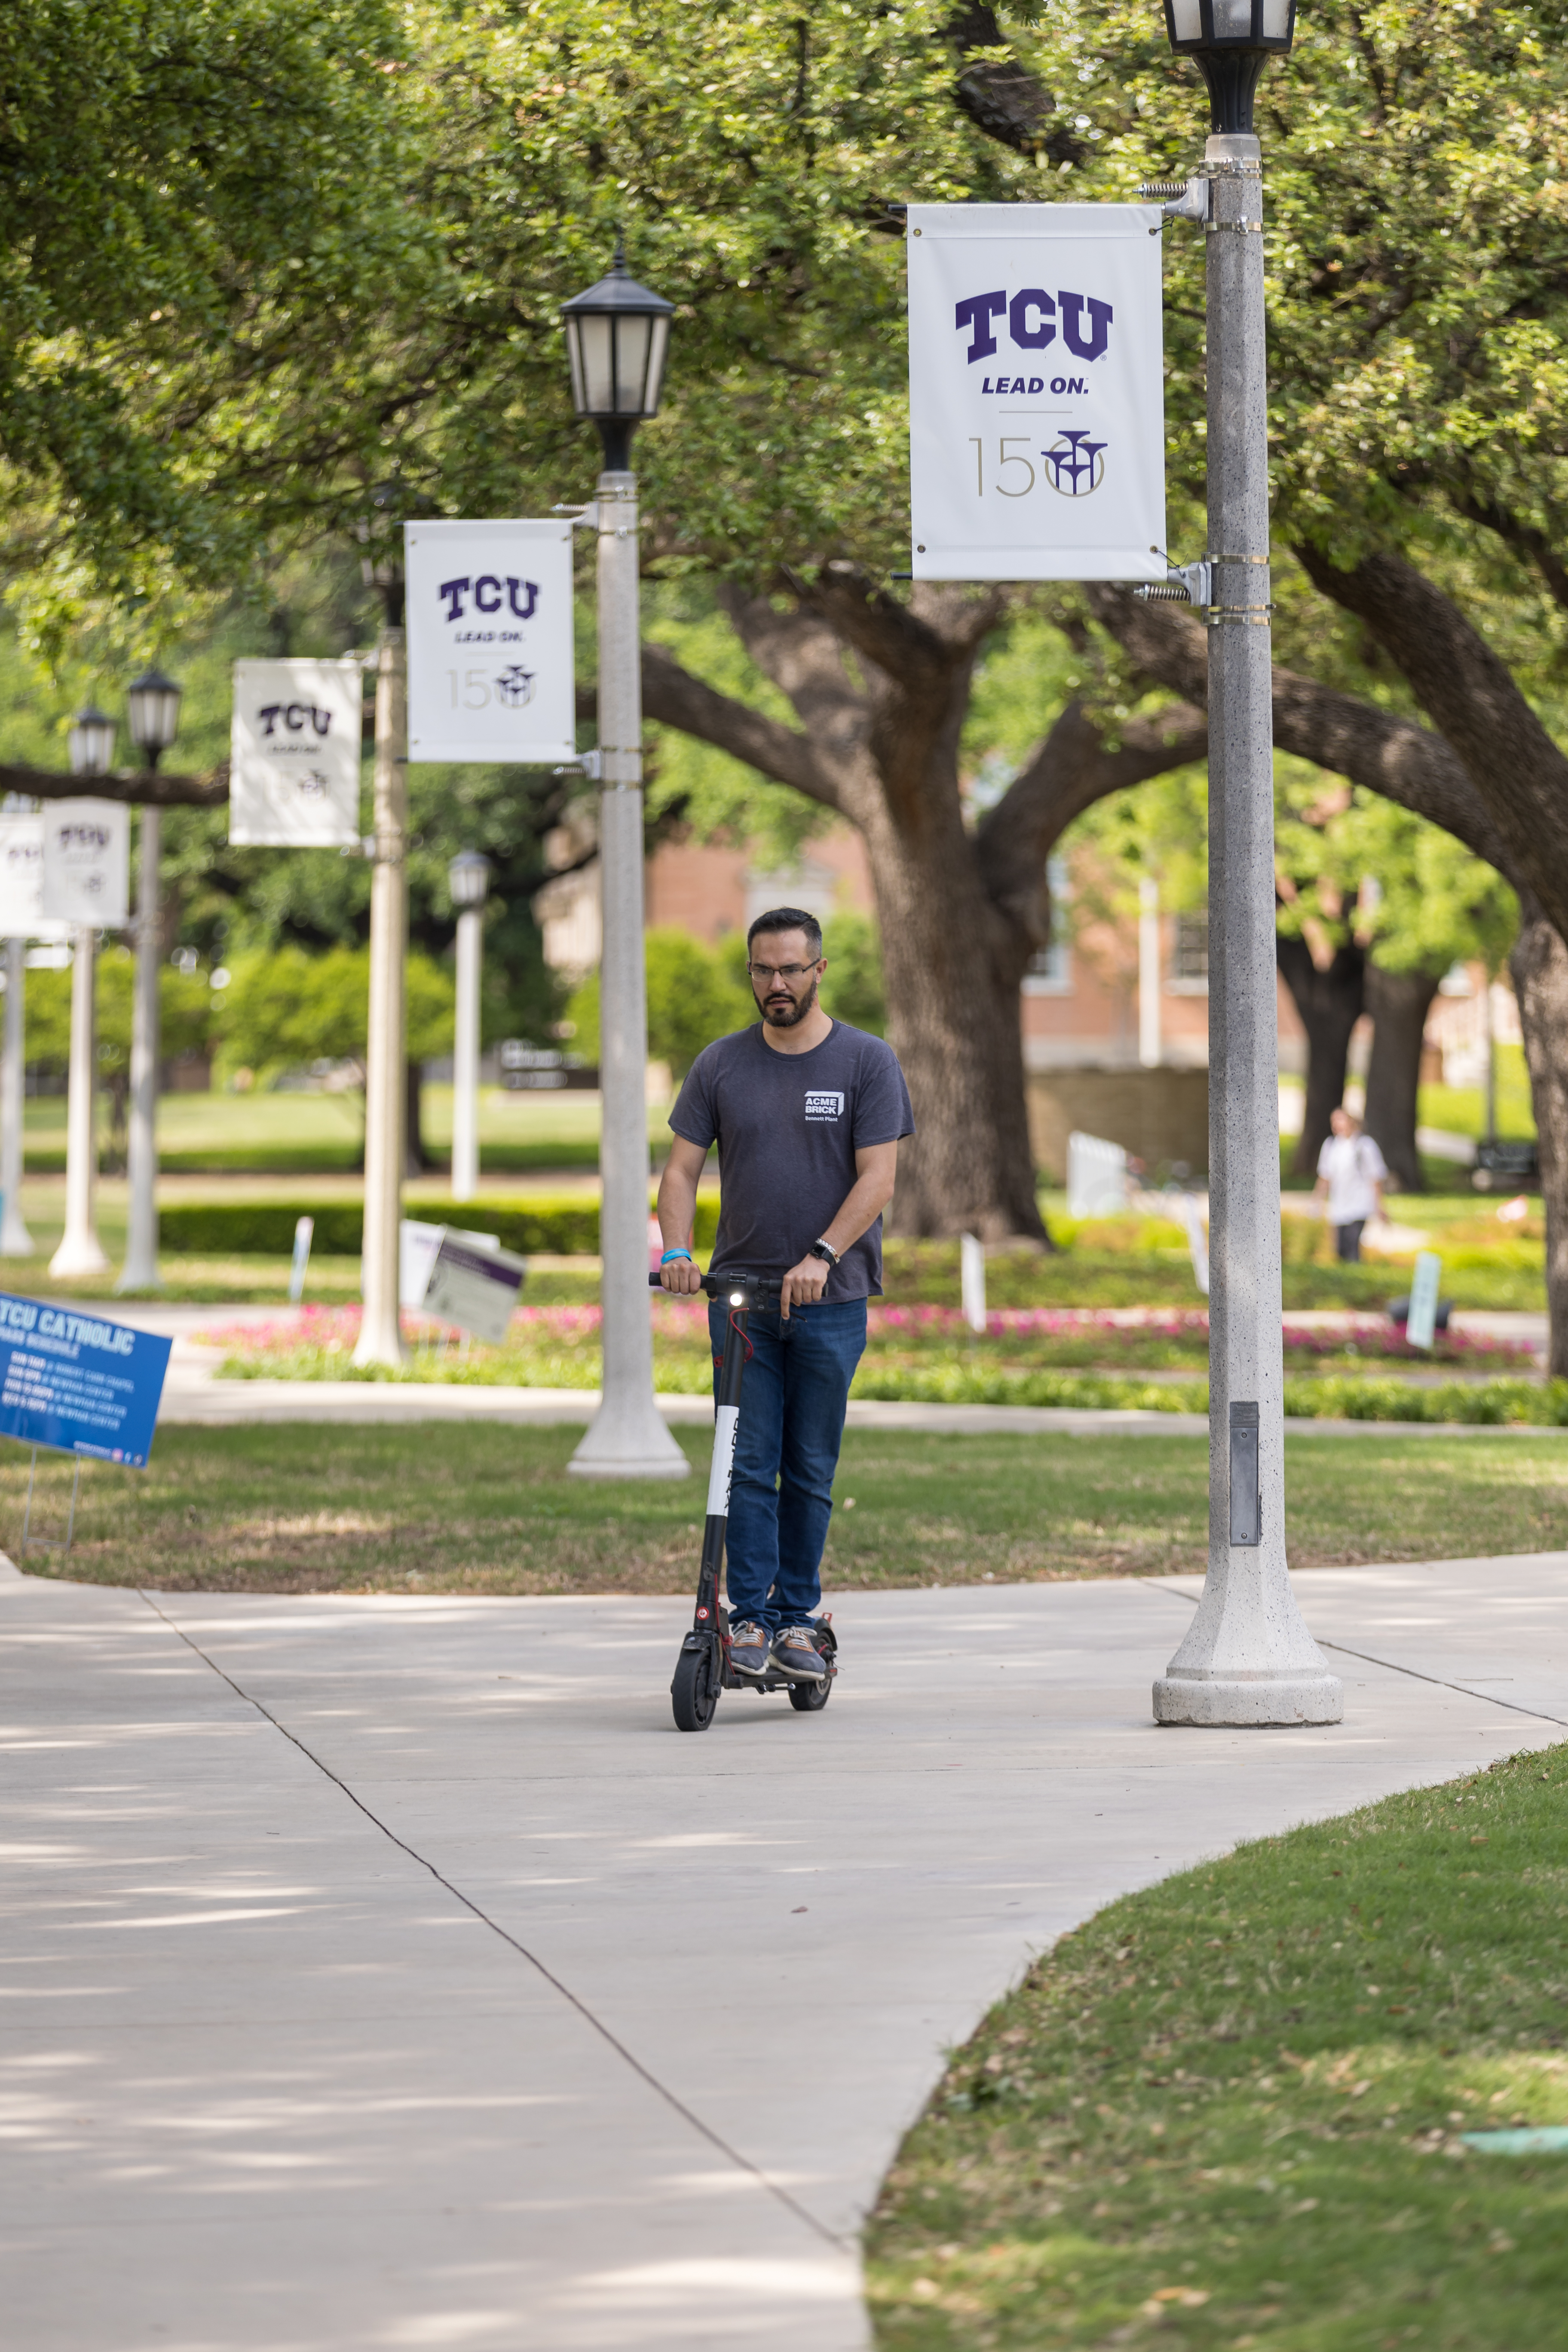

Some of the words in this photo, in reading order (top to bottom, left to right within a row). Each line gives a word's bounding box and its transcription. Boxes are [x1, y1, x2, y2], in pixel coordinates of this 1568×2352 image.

[956, 289, 1113, 364] TCU
[982, 377, 1044, 394] LEAD
[1050, 377, 1089, 394] ON.
[439, 576, 539, 622] TCU
[456, 631, 493, 643] LEAD
[258, 703, 332, 736] TCU
[805, 1098, 837, 1106] ACME
[805, 1106, 836, 1114] BRICK
[0, 1298, 38, 1331] TCU
[38, 1309, 136, 1356] CATHOLIC
